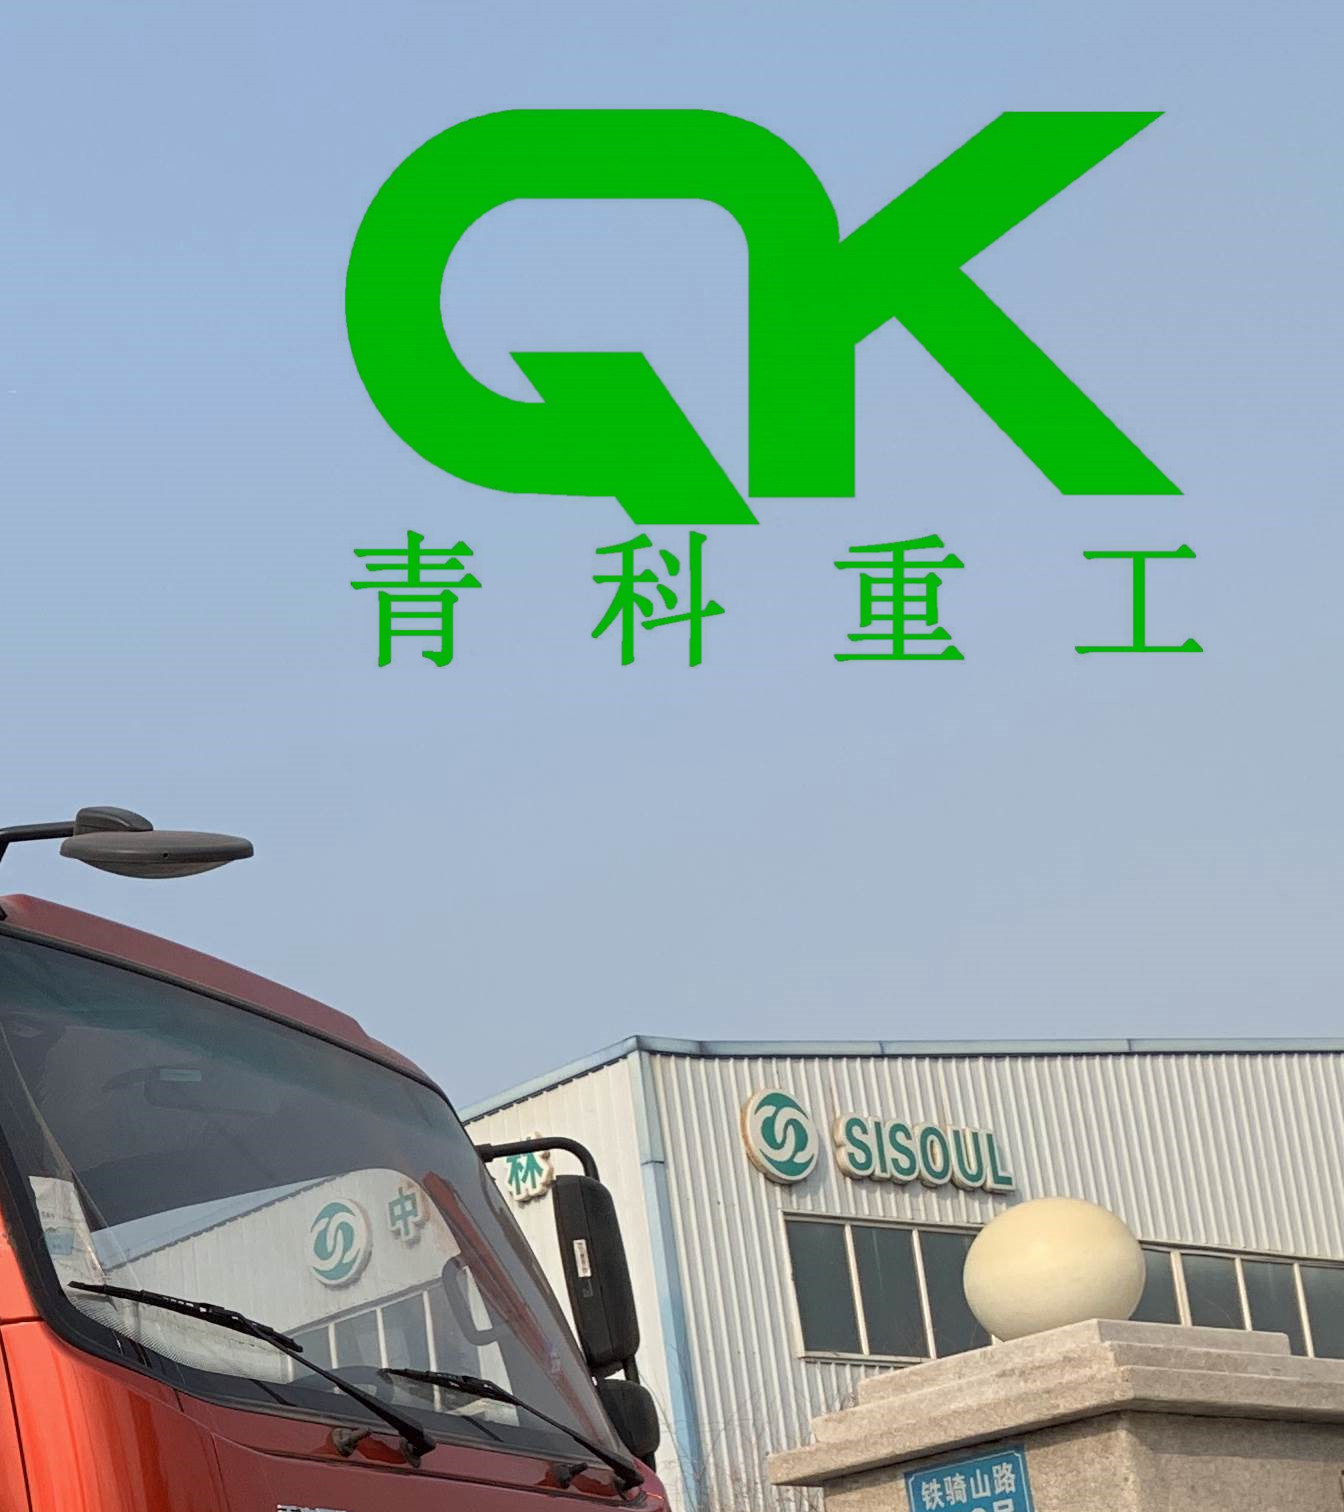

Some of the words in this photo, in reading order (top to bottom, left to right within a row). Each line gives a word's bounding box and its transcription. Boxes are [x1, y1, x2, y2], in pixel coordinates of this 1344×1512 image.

[845, 1116, 1014, 1187] SISOUL
[920, 1461, 1017, 1511] 铁骑山路
